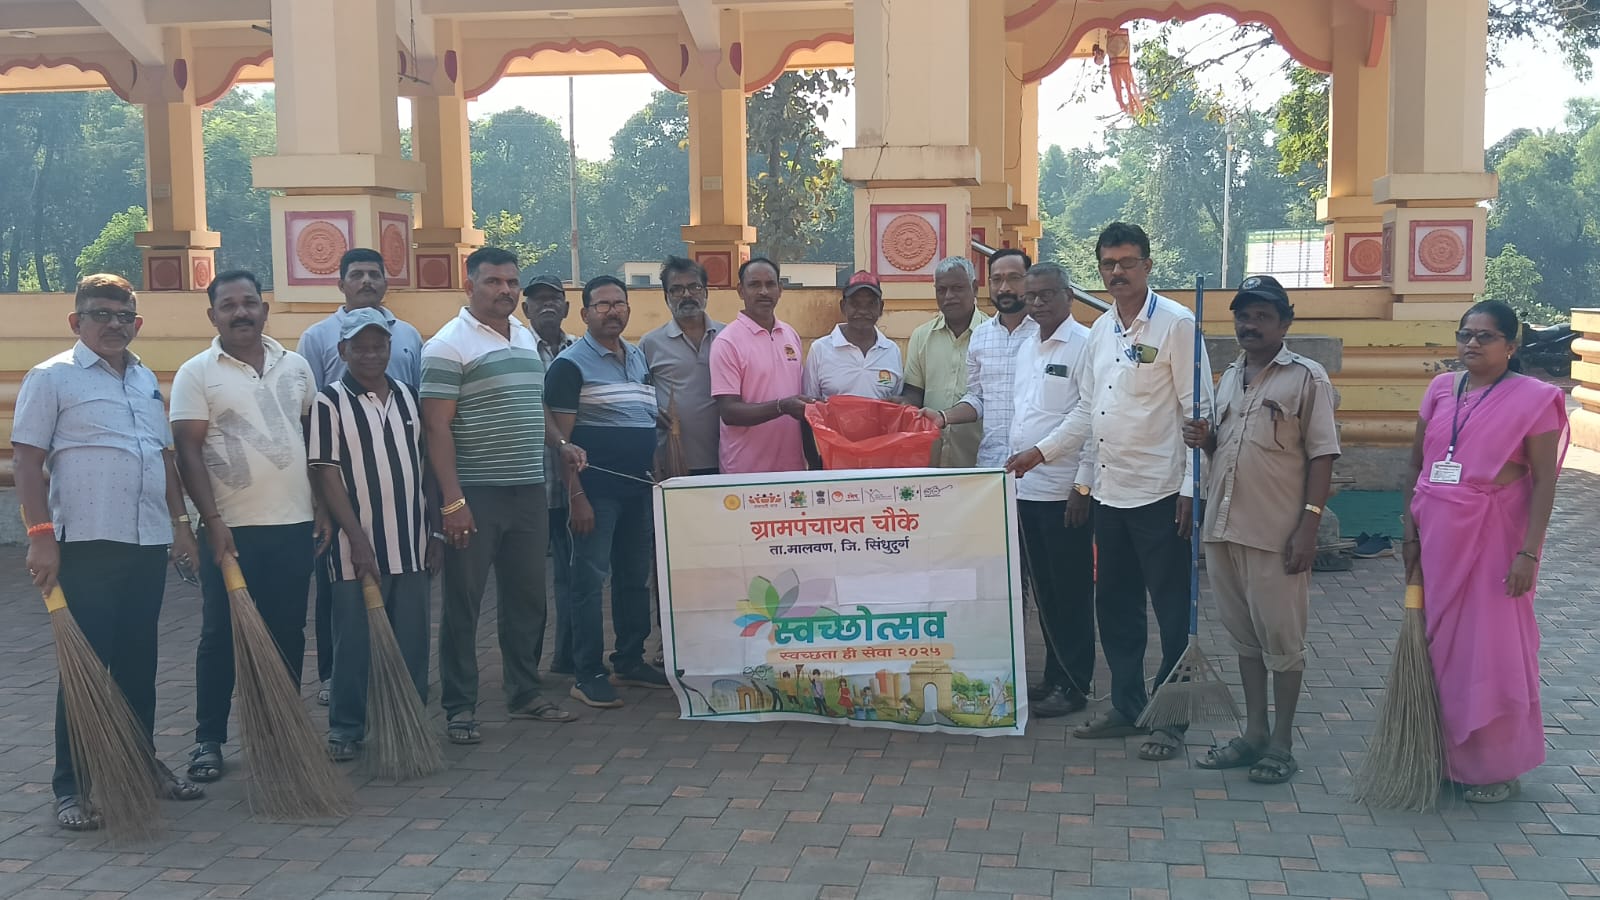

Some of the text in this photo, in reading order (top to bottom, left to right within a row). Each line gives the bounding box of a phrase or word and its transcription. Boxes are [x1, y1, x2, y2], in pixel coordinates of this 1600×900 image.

[751, 506, 920, 541] ग्रामपंचायत चौके
[841, 538, 861, 552] जि.
[866, 535, 910, 555] सिंधुदुर्ग
[772, 605, 948, 645] स्वच्छोत्सव
[779, 646, 942, 661] स्वच्छता ही सेवा २०२५
